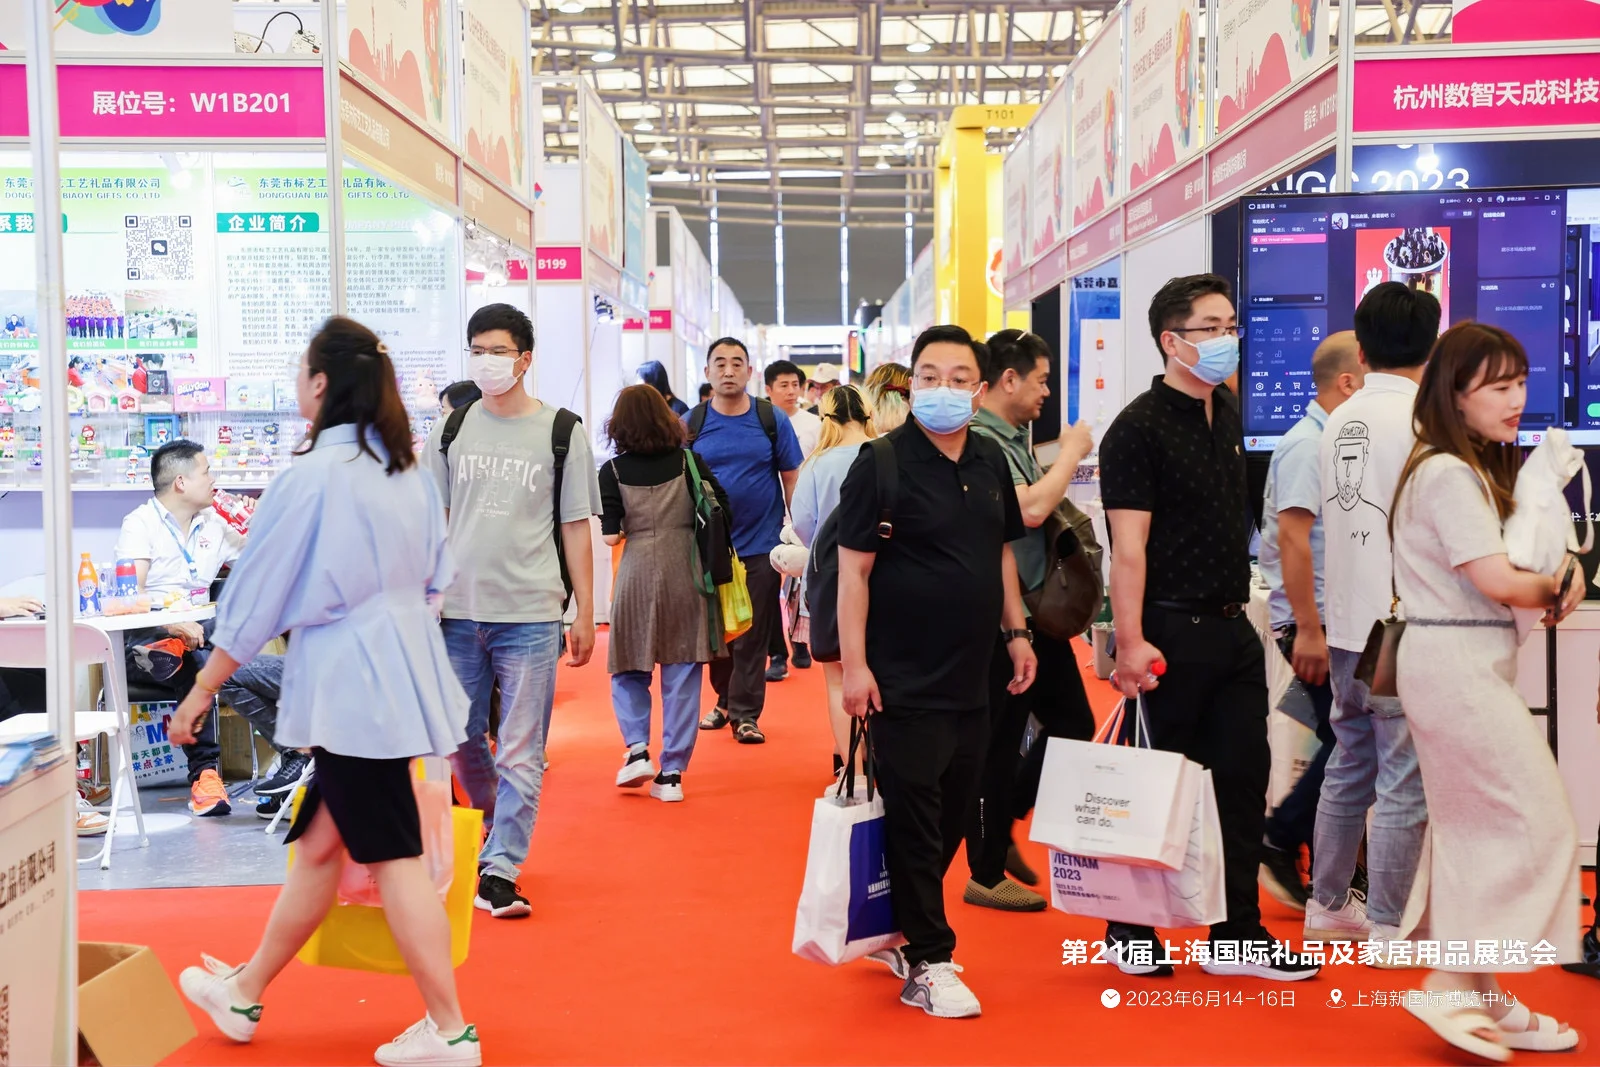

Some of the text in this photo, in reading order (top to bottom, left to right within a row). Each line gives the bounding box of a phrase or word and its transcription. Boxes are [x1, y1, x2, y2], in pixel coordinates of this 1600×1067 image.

[1393, 77, 1600, 110] 杭州数智天成科技
[190, 92, 291, 113] W1B201
[985, 109, 1015, 120] T101
[259, 191, 311, 199] DONGGUAN
[348, 191, 373, 199] GIFTS
[228, 214, 307, 232] 企业简介
[518, 258, 567, 270] WB199
[457, 454, 542, 493] ATHLETIC
[1350, 530, 1371, 546] NY
[1085, 792, 1131, 807] Discover
[1074, 804, 1101, 815] what
[1076, 815, 1115, 828] can do.
[1053, 866, 1082, 881] 2023
